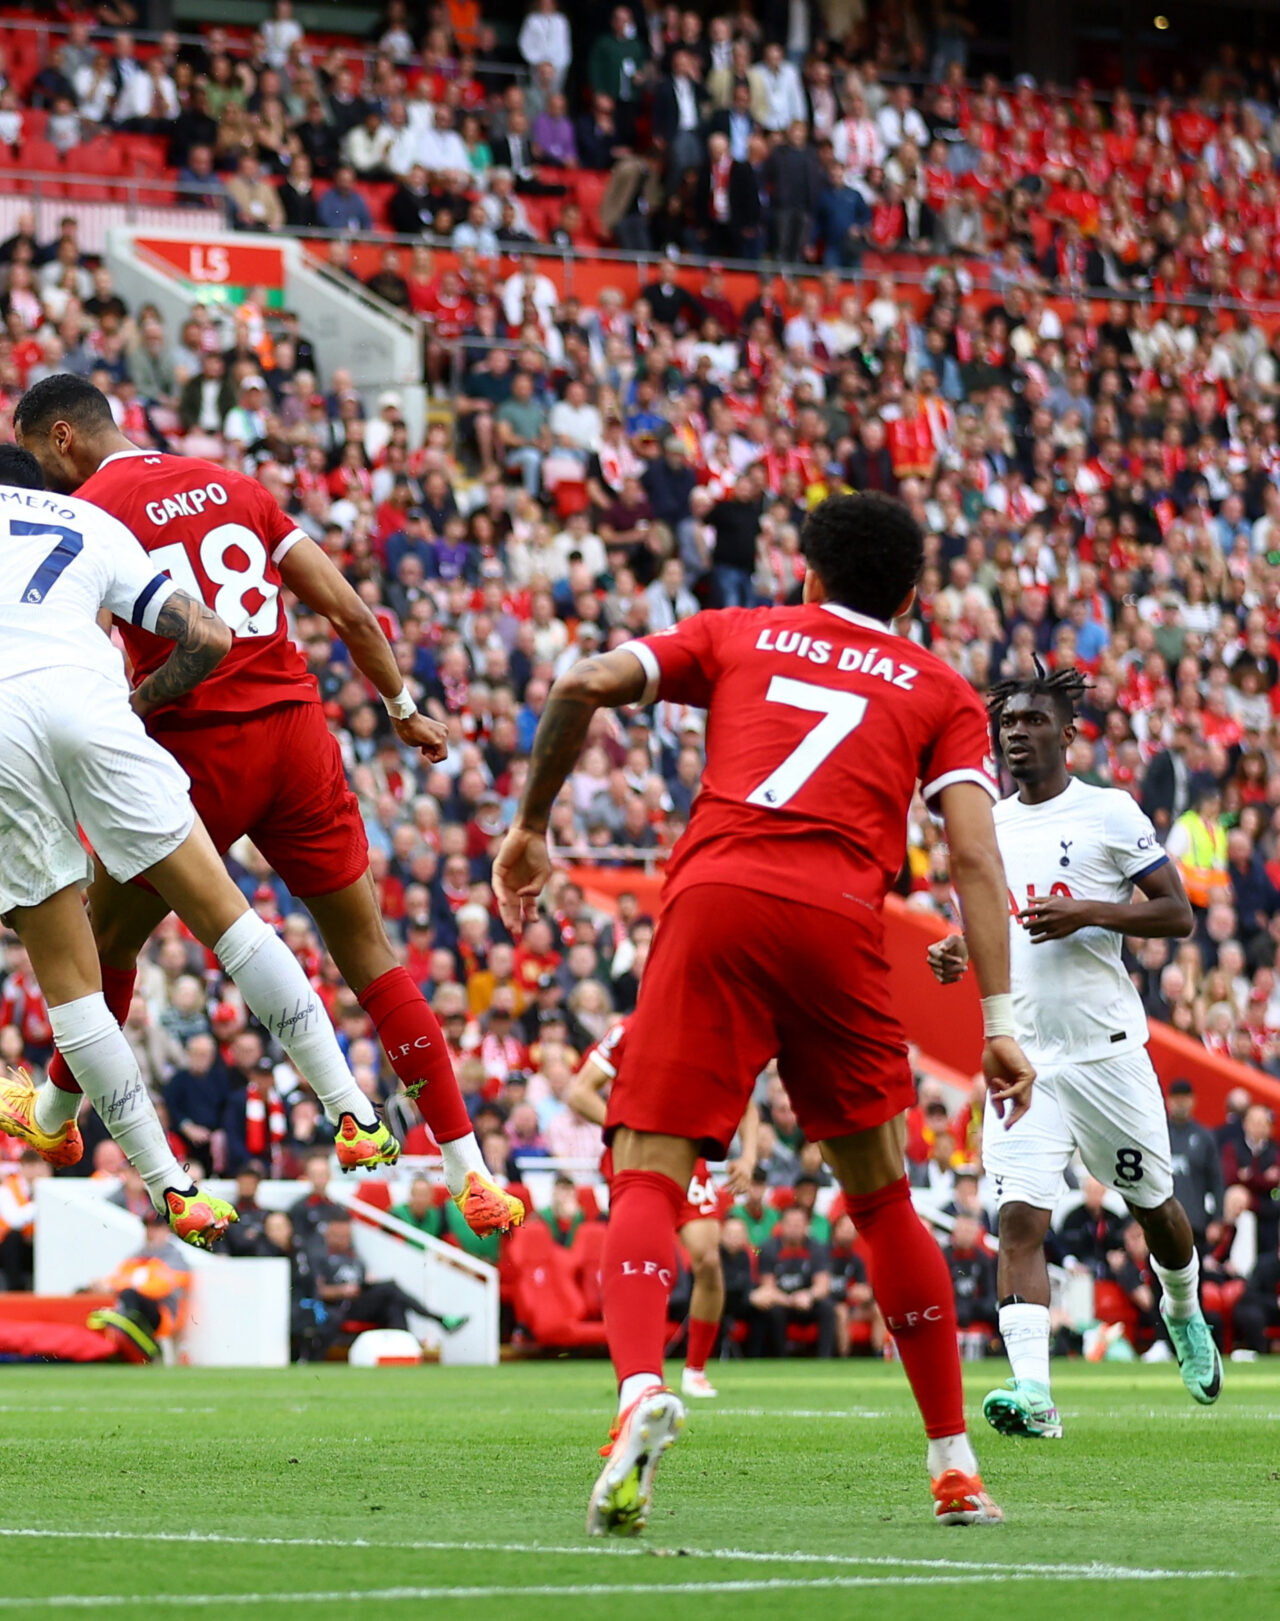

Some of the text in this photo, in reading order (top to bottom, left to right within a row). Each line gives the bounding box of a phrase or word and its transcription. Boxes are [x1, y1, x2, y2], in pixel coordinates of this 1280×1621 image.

[190, 246, 230, 282] L5
[145, 482, 228, 526] GAKPO
[149, 522, 279, 638] 18
[755, 629, 919, 690] LUIS DÍAZ
[745, 675, 869, 809] 7
[387, 1035, 431, 1061] LFC
[1115, 1148, 1144, 1182] 8
[621, 1260, 671, 1287] LFC
[887, 1305, 942, 1329] LFC
